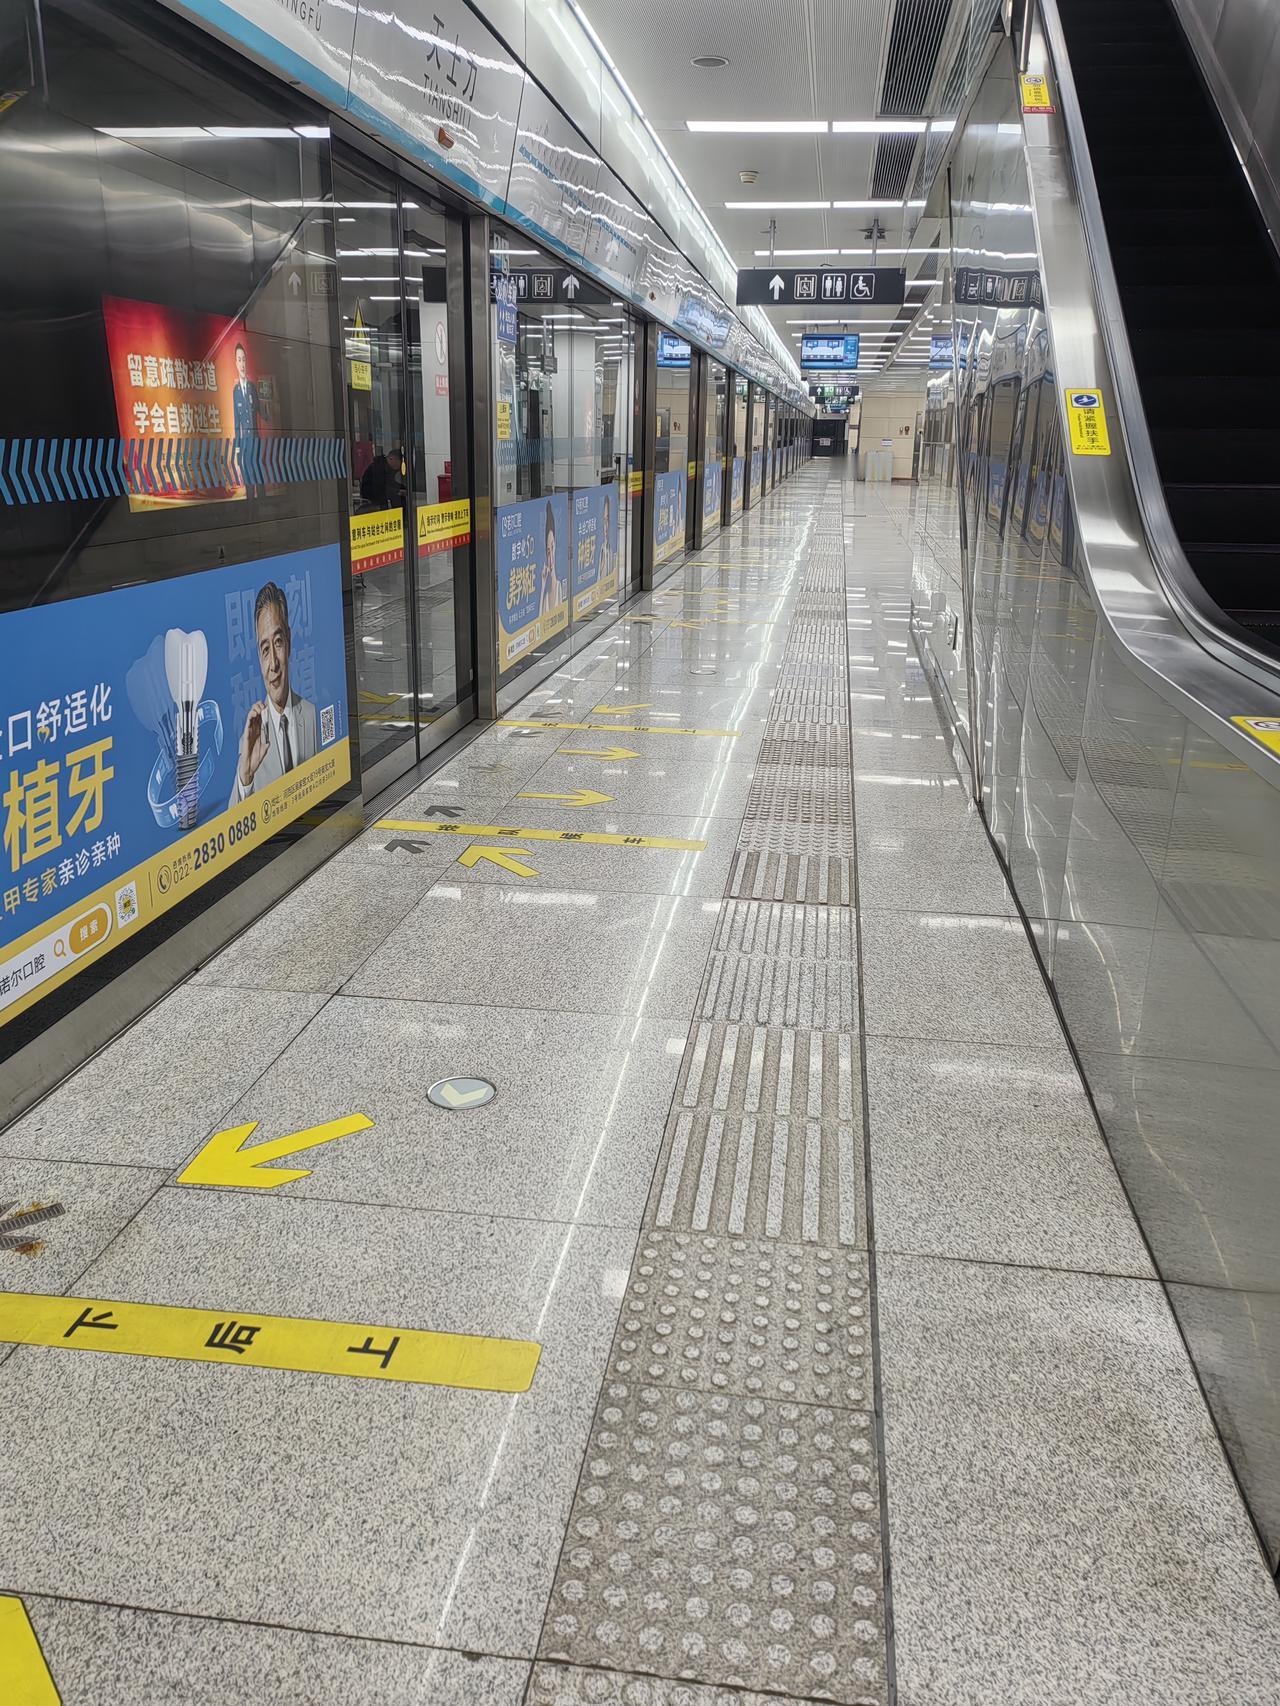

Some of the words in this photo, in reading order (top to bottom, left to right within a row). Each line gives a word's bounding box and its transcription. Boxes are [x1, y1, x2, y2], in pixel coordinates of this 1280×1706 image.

[426, 14, 477, 102] 天士力
[127, 352, 218, 392] 留意疏散通道
[132, 401, 223, 434] 学会自救逃生
[0, 682, 112, 760] 口舒适化
[3, 736, 115, 873] 植牙
[436, 823, 645, 845] 排队候车
[0, 832, 121, 921] 甲专家亲诊亲种
[63, 1306, 401, 1369] 下后上
